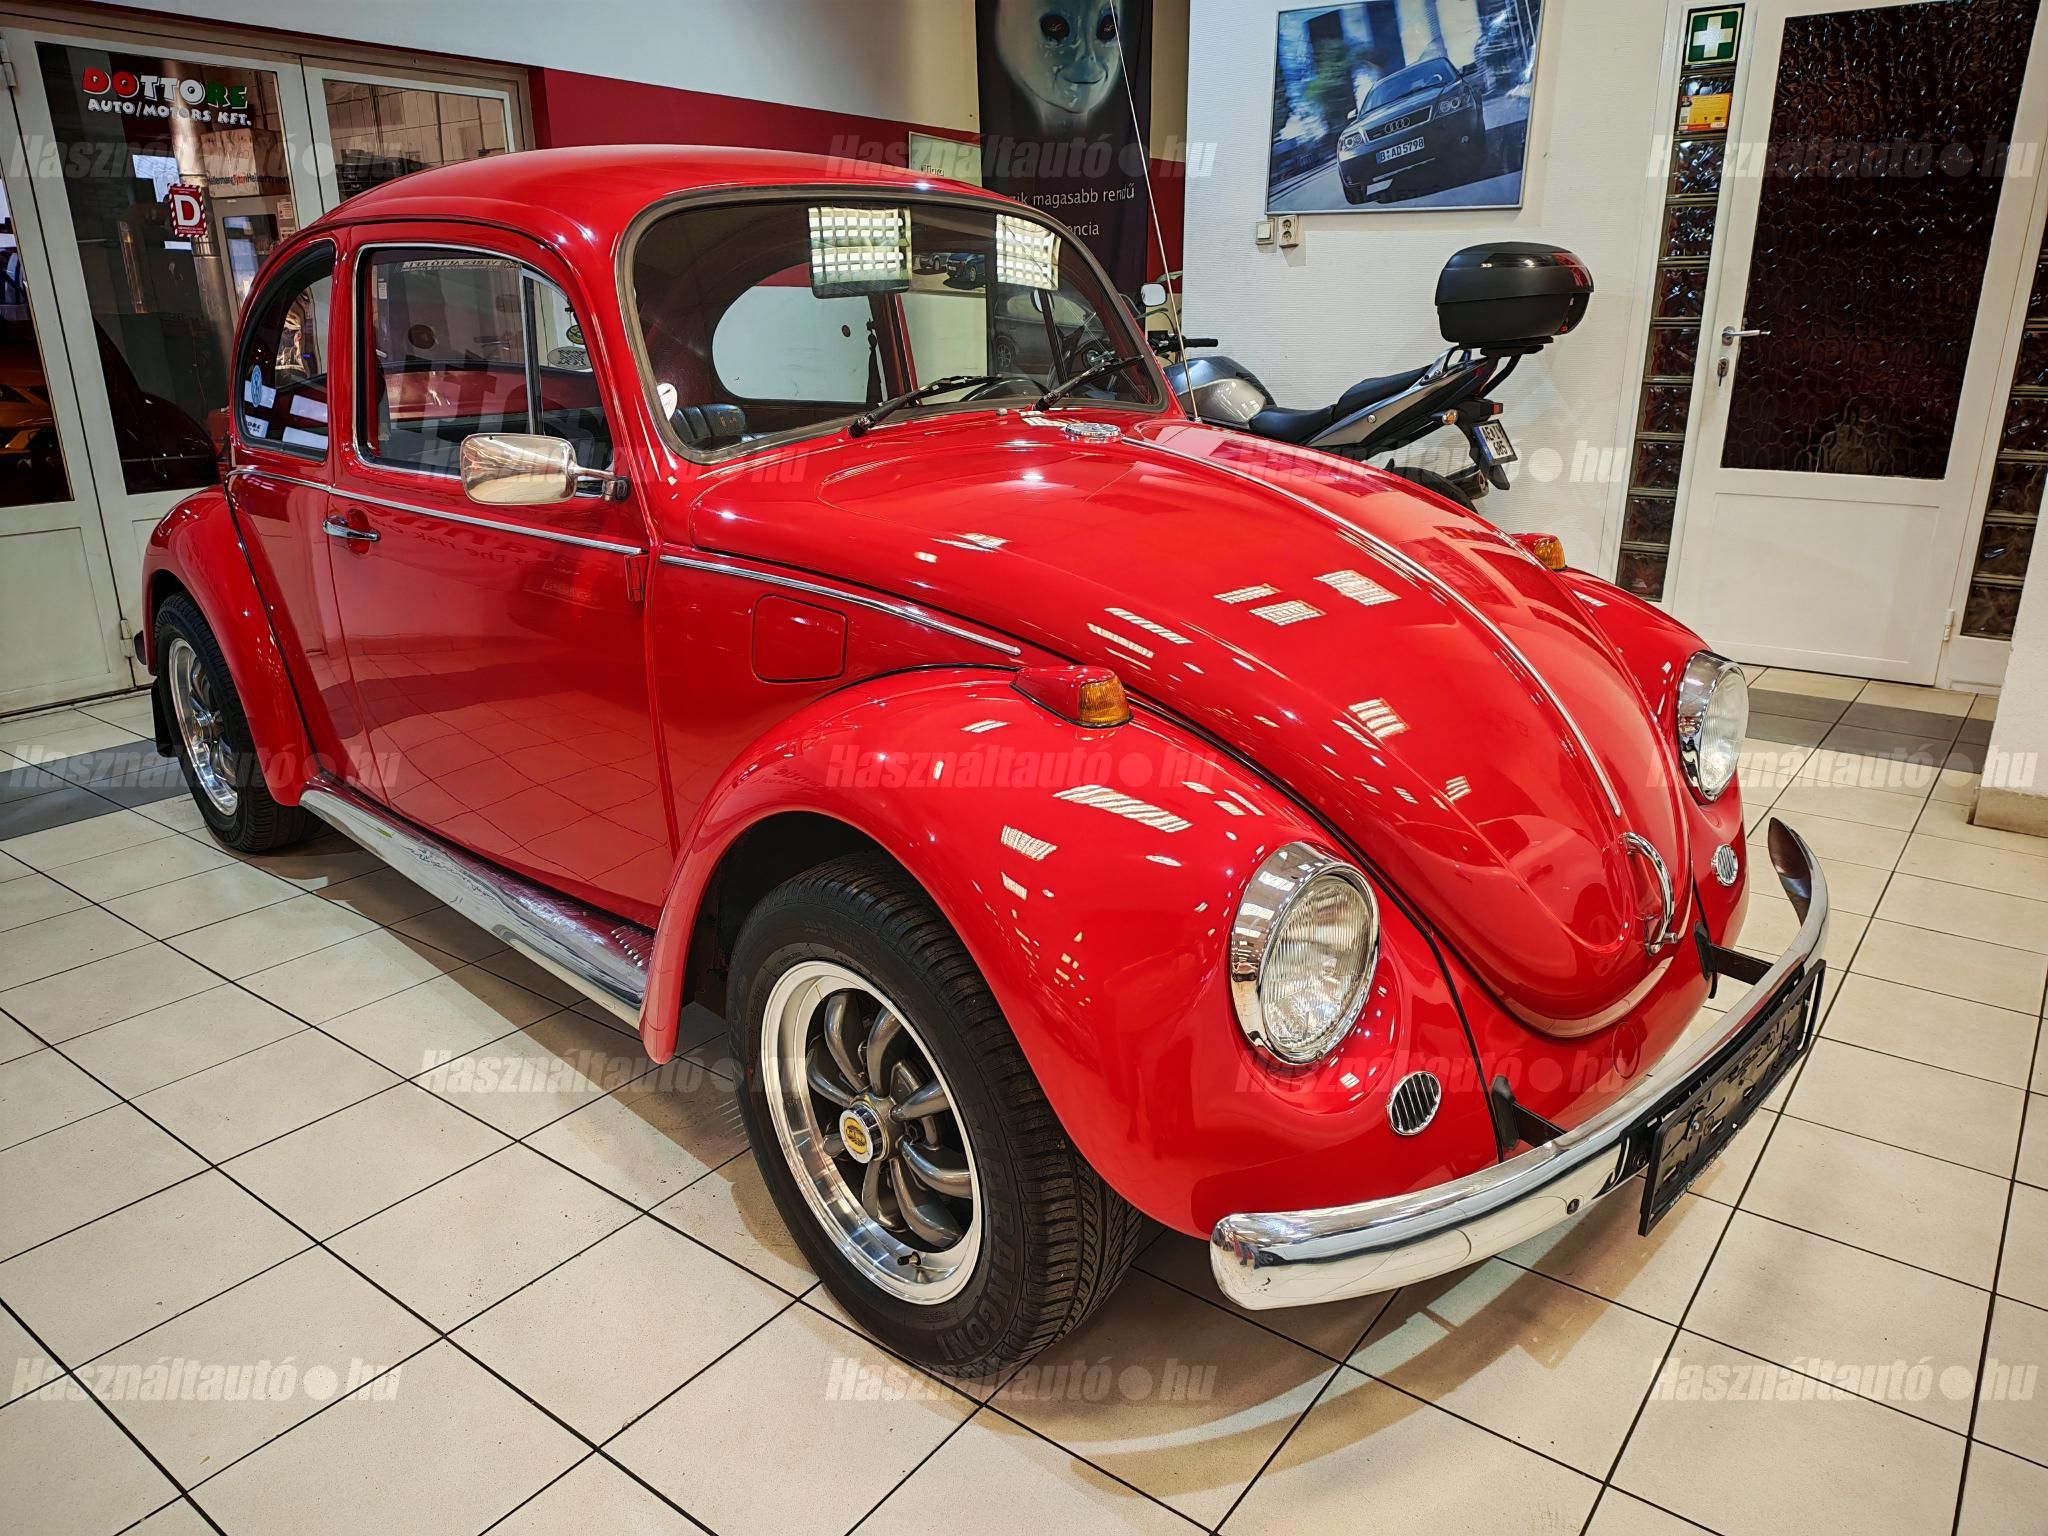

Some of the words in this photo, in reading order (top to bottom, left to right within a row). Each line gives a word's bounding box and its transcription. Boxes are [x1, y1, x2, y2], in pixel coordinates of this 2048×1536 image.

[82, 66, 249, 110] DOTTORE
[173, 194, 201, 227] D
[1032, 187, 1099, 209] magasabb
[1102, 182, 1136, 203] rendű
